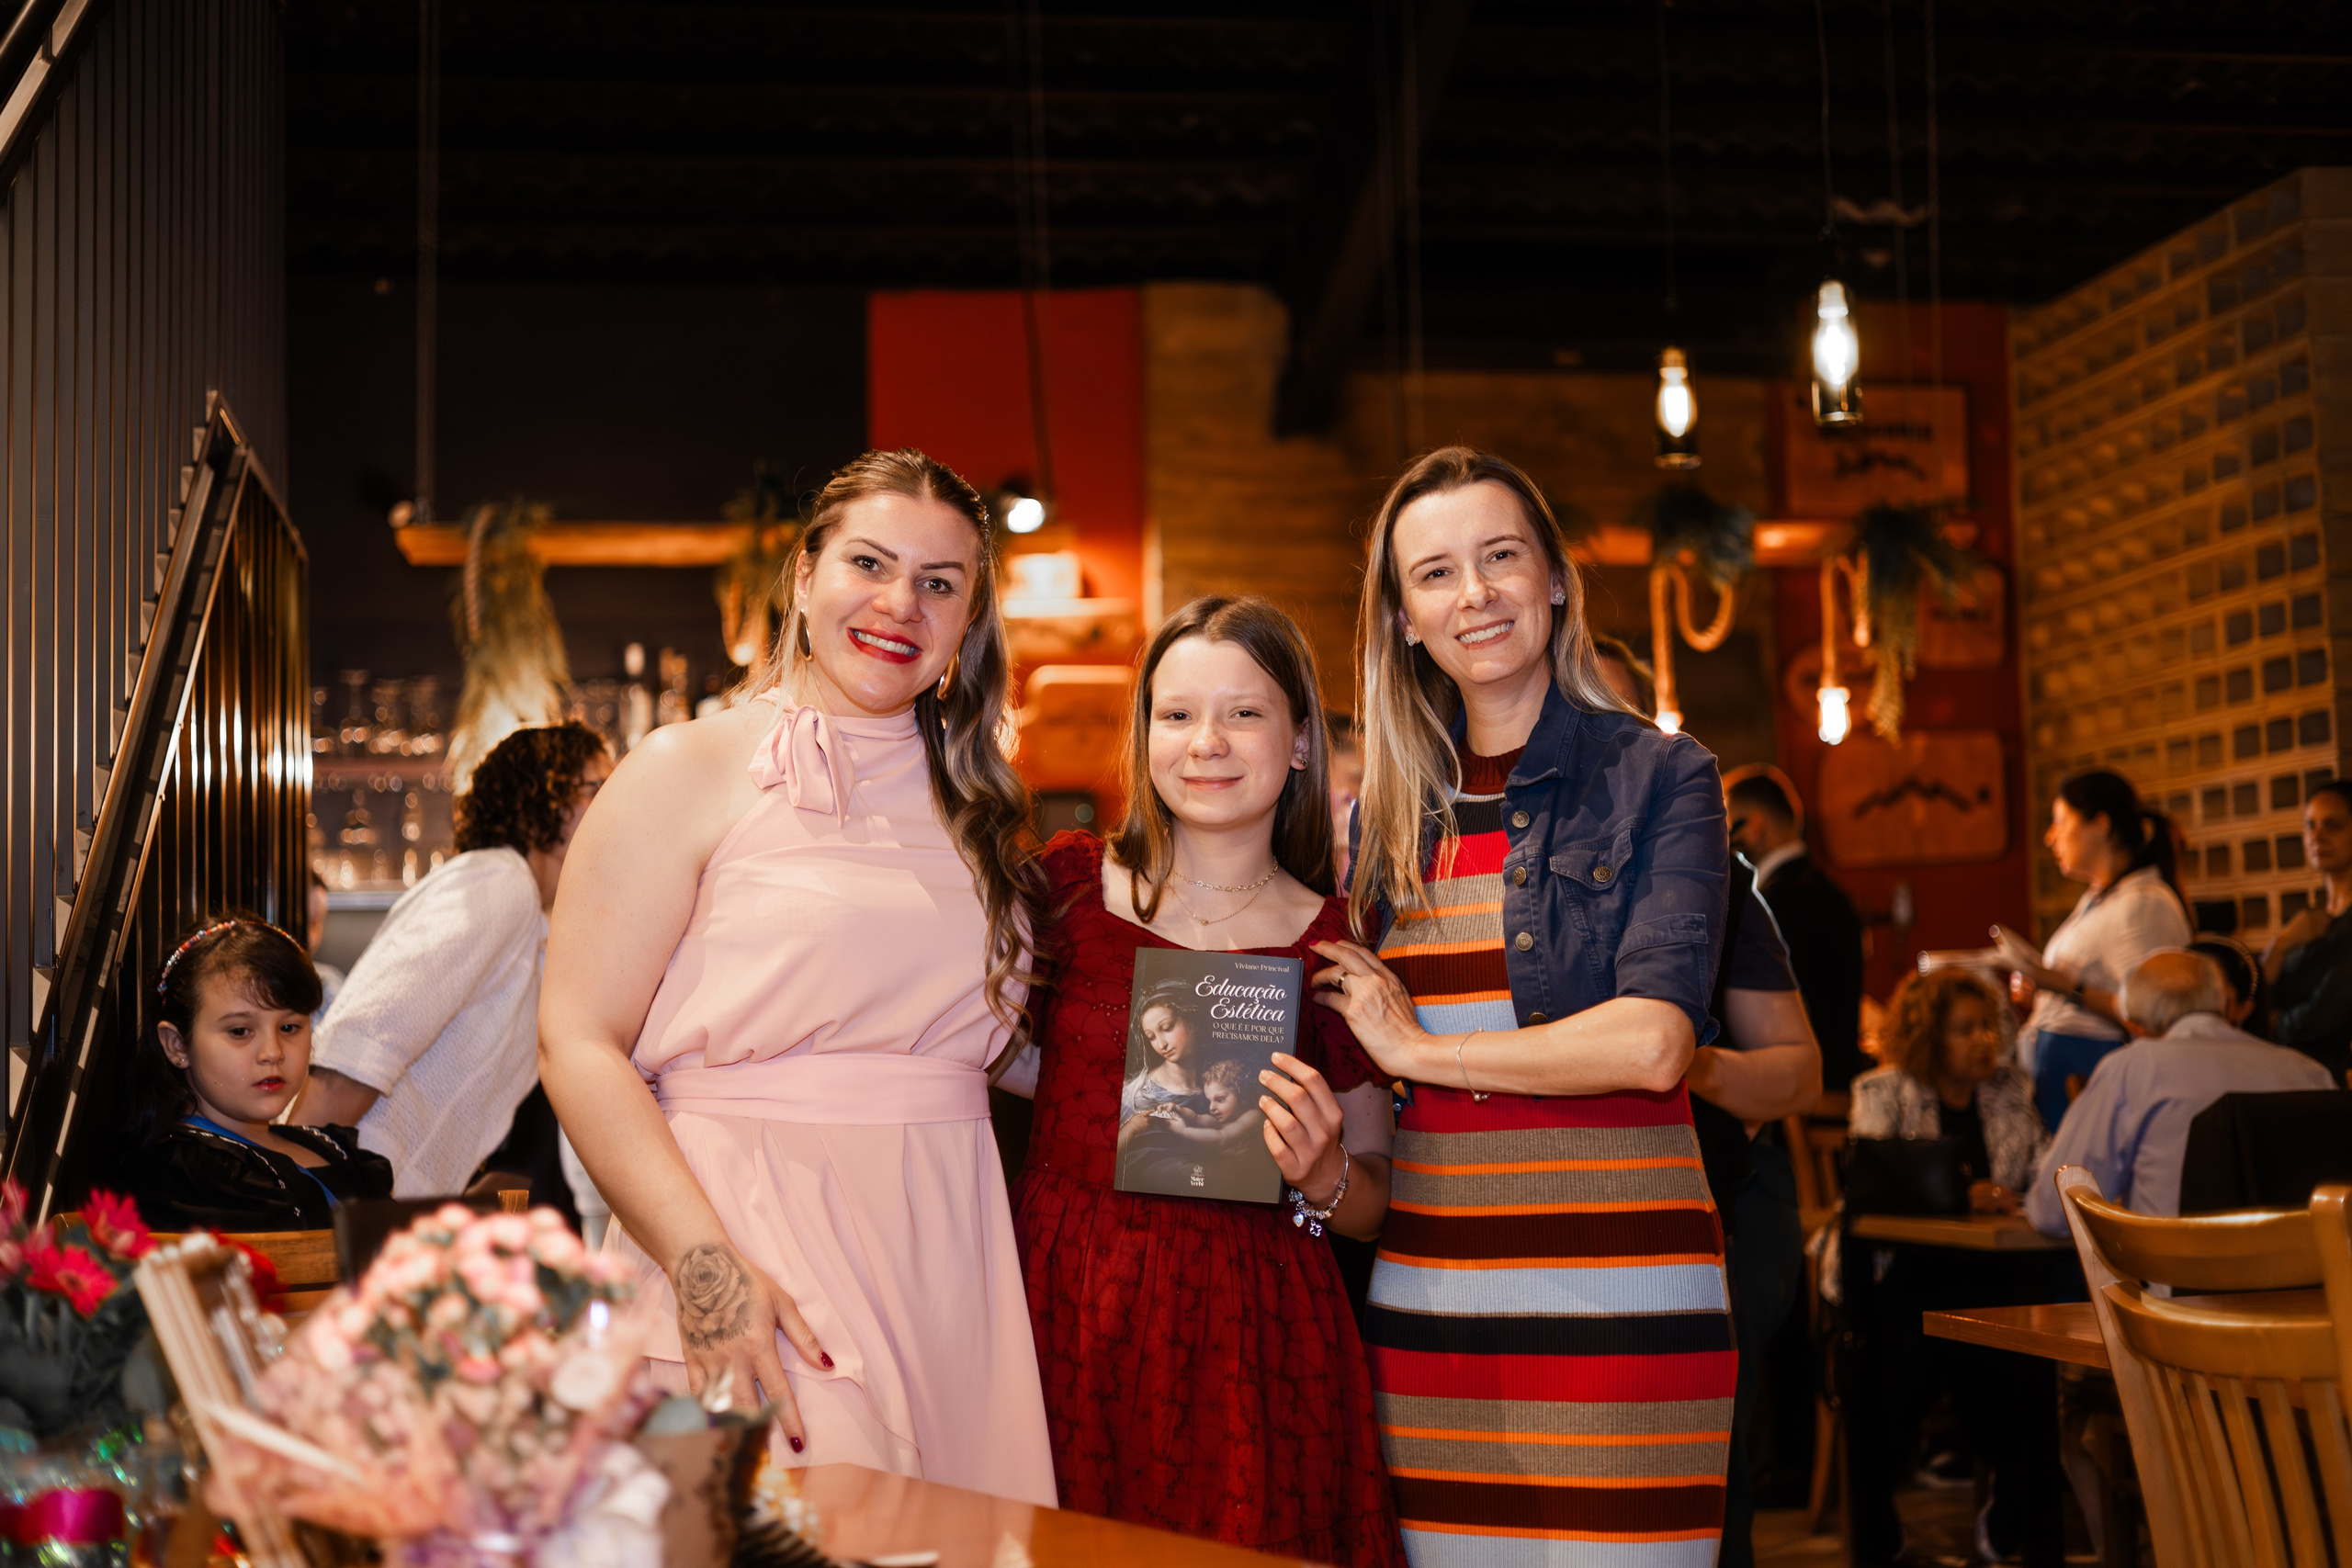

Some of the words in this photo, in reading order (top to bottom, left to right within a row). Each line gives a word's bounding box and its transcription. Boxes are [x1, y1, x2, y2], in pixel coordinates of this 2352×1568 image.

[1235, 962, 1259, 970] Viviane
[1261, 964, 1289, 973] Princival
[1195, 975, 1287, 1004] Educação
[1210, 998, 1285, 1022] Estética
[1221, 1022, 1237, 1032] QUE
[1238, 1021, 1243, 1031] É
[1250, 1024, 1267, 1033] POR
[1268, 1026, 1284, 1034] QUE
[1212, 1031, 1259, 1042] PRECISAMOS
[1261, 1035, 1284, 1043] DELA?
